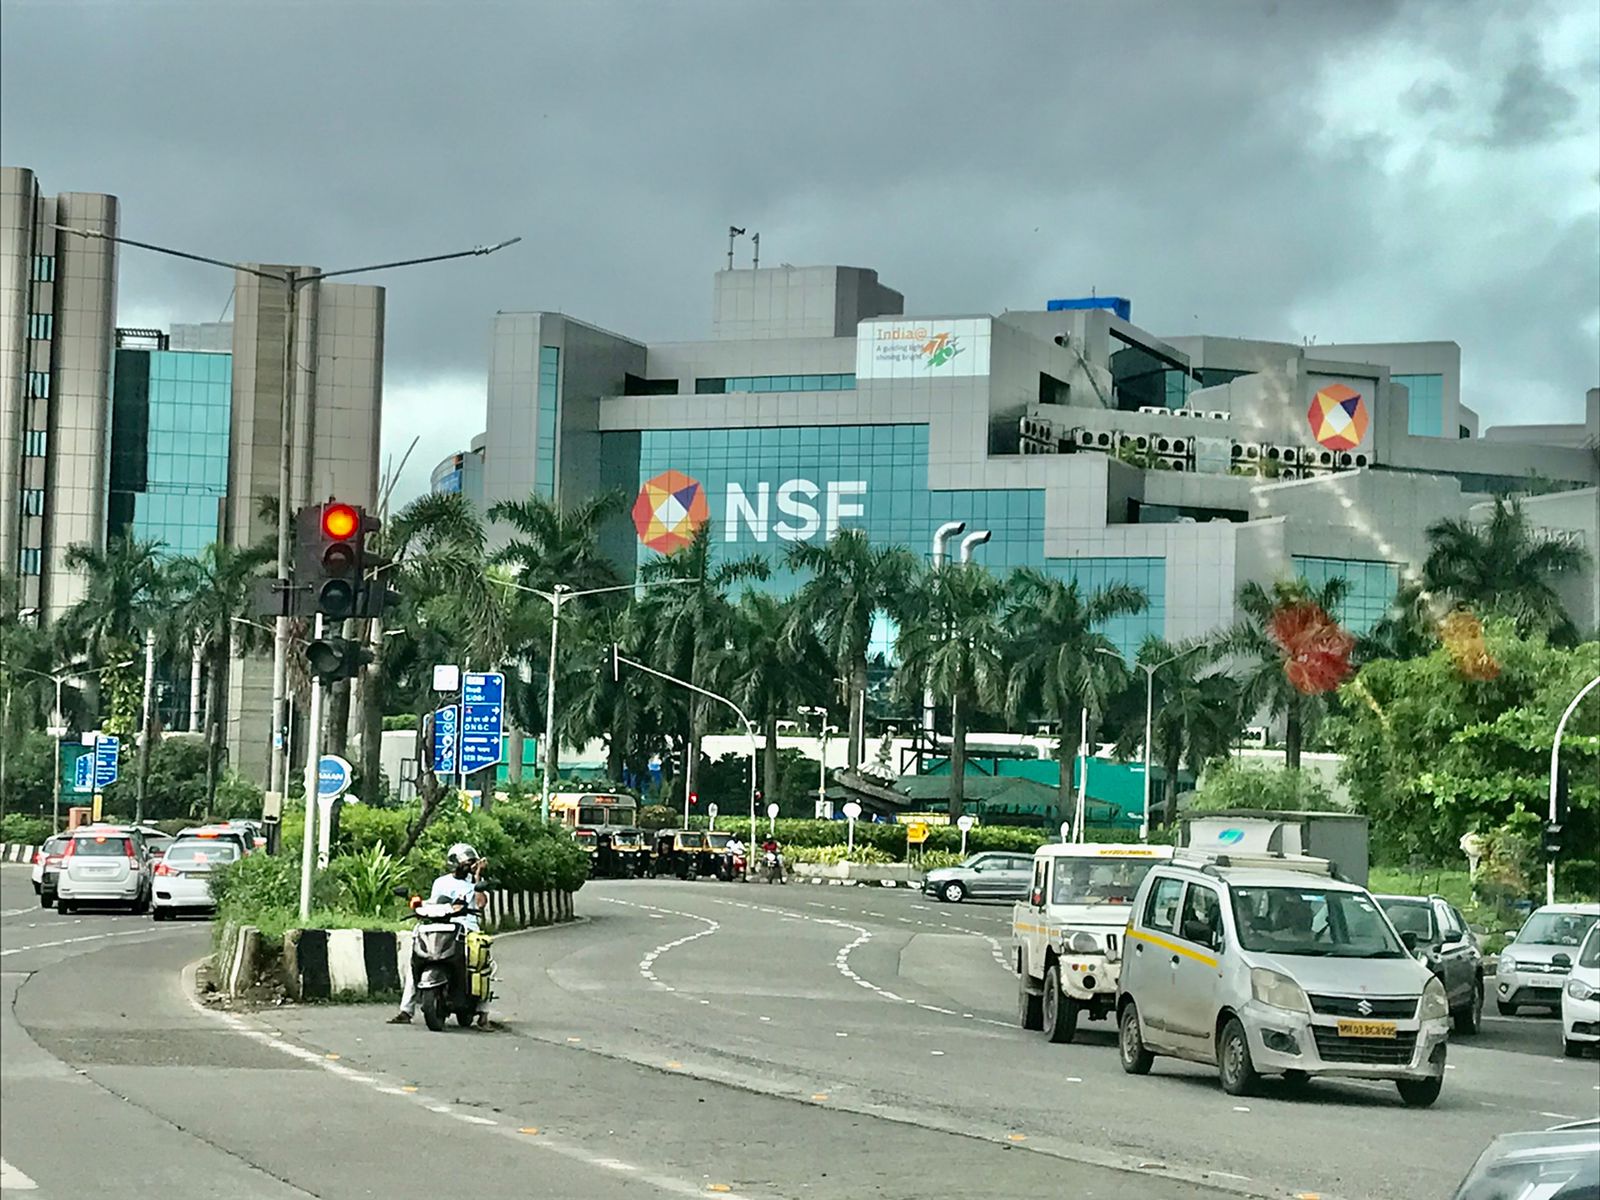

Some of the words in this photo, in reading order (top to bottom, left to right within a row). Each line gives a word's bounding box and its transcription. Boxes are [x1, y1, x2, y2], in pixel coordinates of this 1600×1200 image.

[876, 353, 901, 362] shining
[902, 353, 922, 362] bright
[464, 723, 490, 731] ONGC
